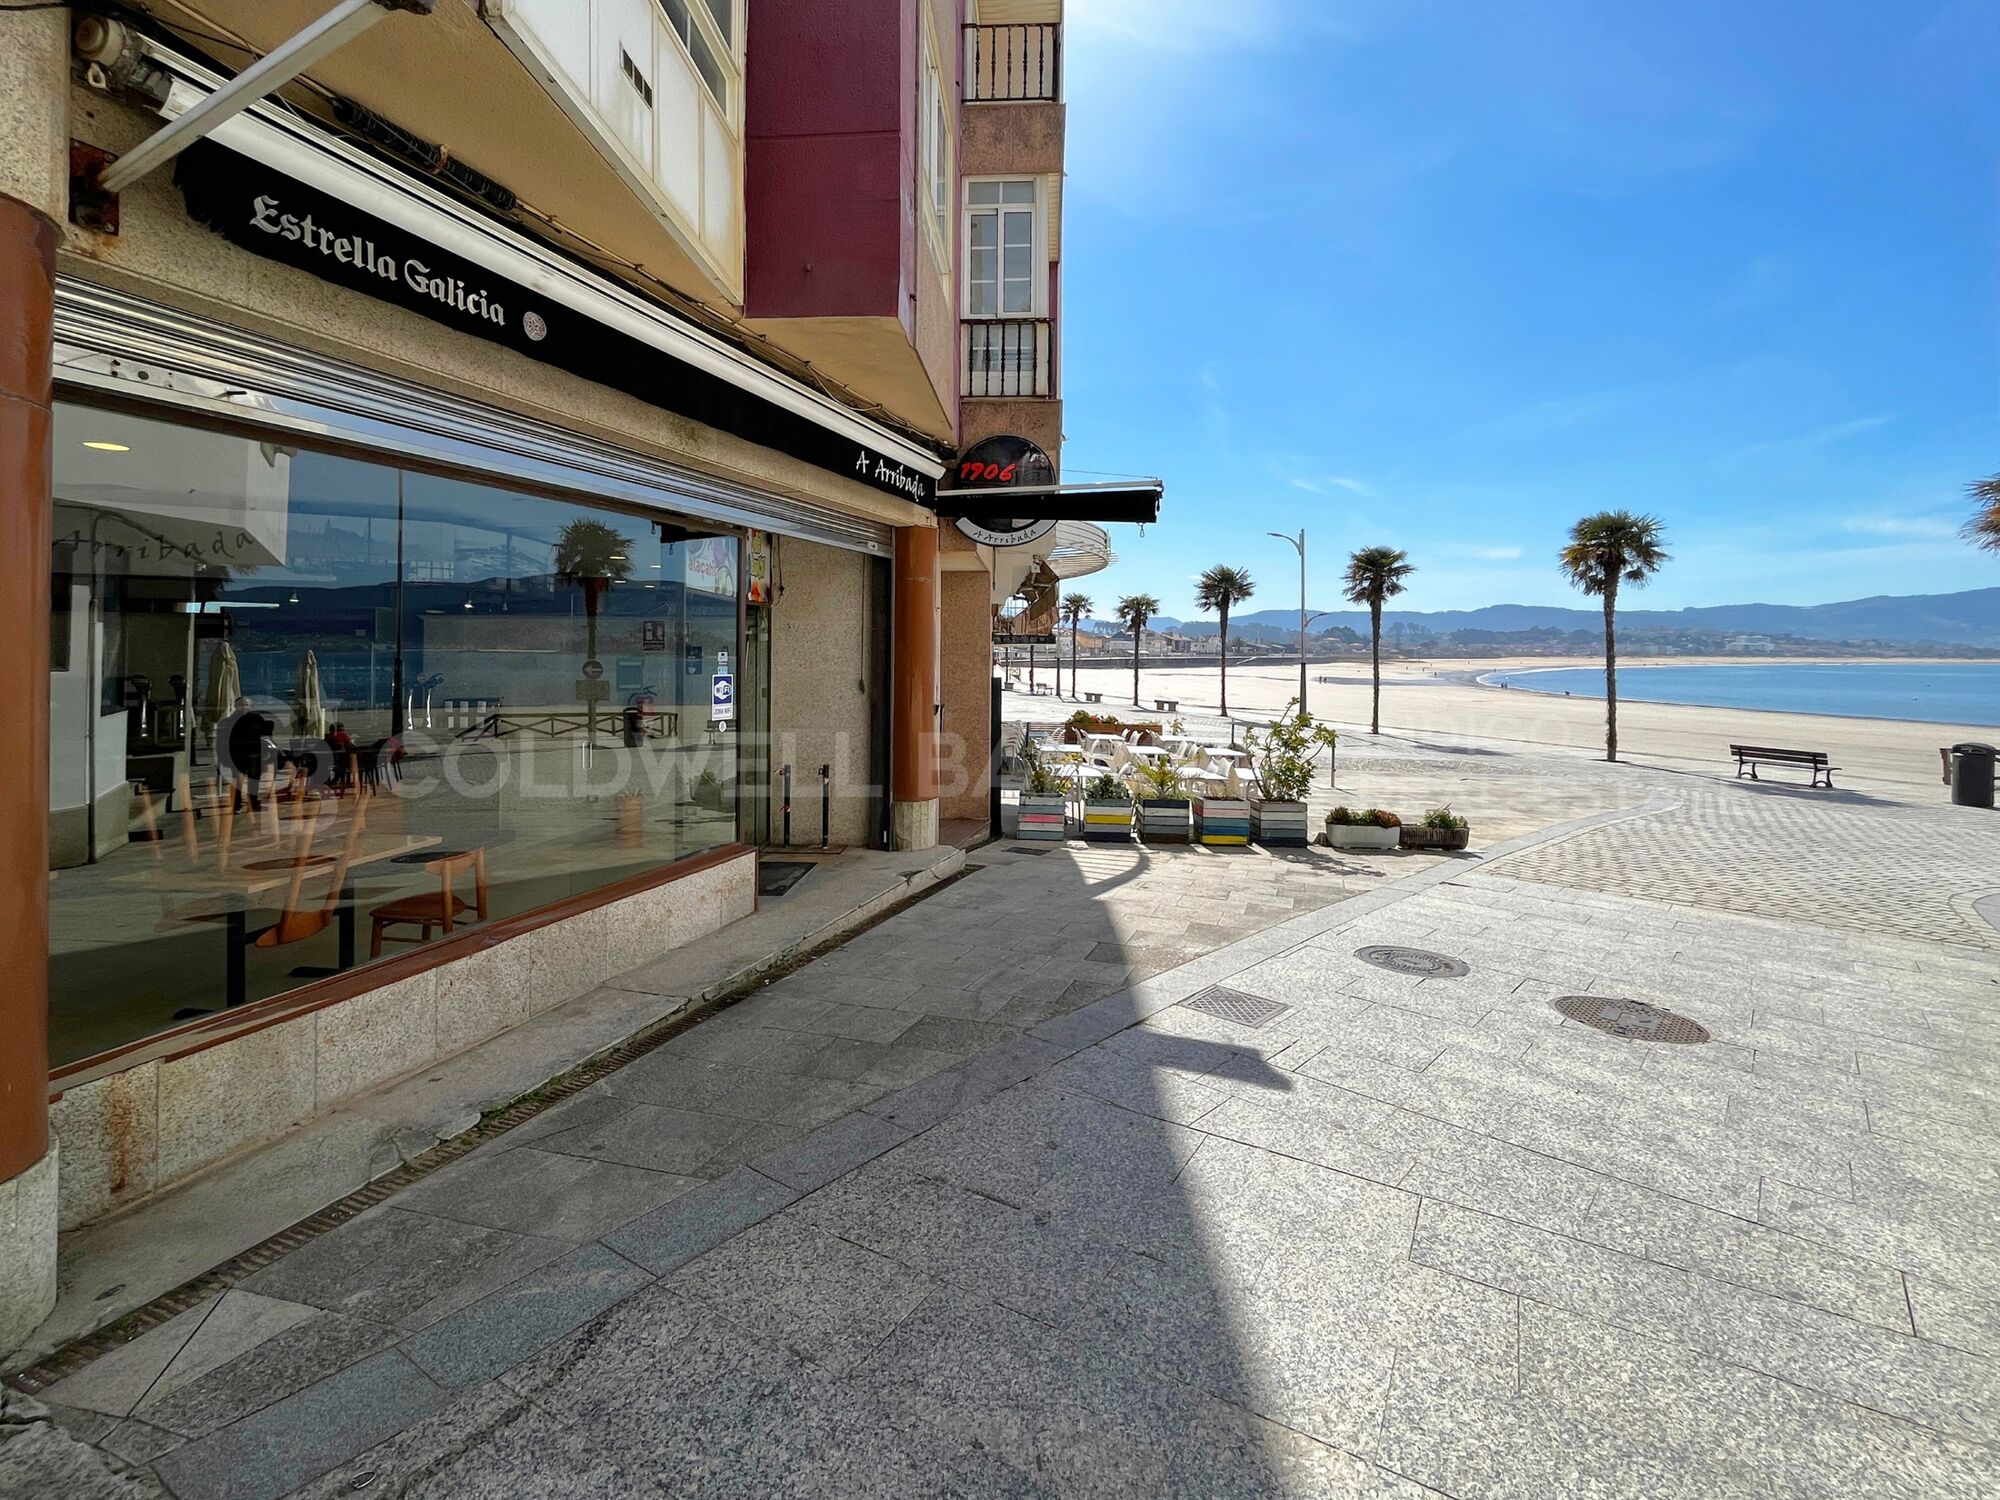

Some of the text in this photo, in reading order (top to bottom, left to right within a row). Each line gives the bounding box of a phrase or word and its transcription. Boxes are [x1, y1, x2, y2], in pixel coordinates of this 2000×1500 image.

[250, 195, 506, 326] Estrella Galicia
[856, 450, 870, 474] A
[875, 459, 926, 502] Arribada
[960, 462, 1016, 481] 1906
[984, 528, 1037, 544] Arribada
